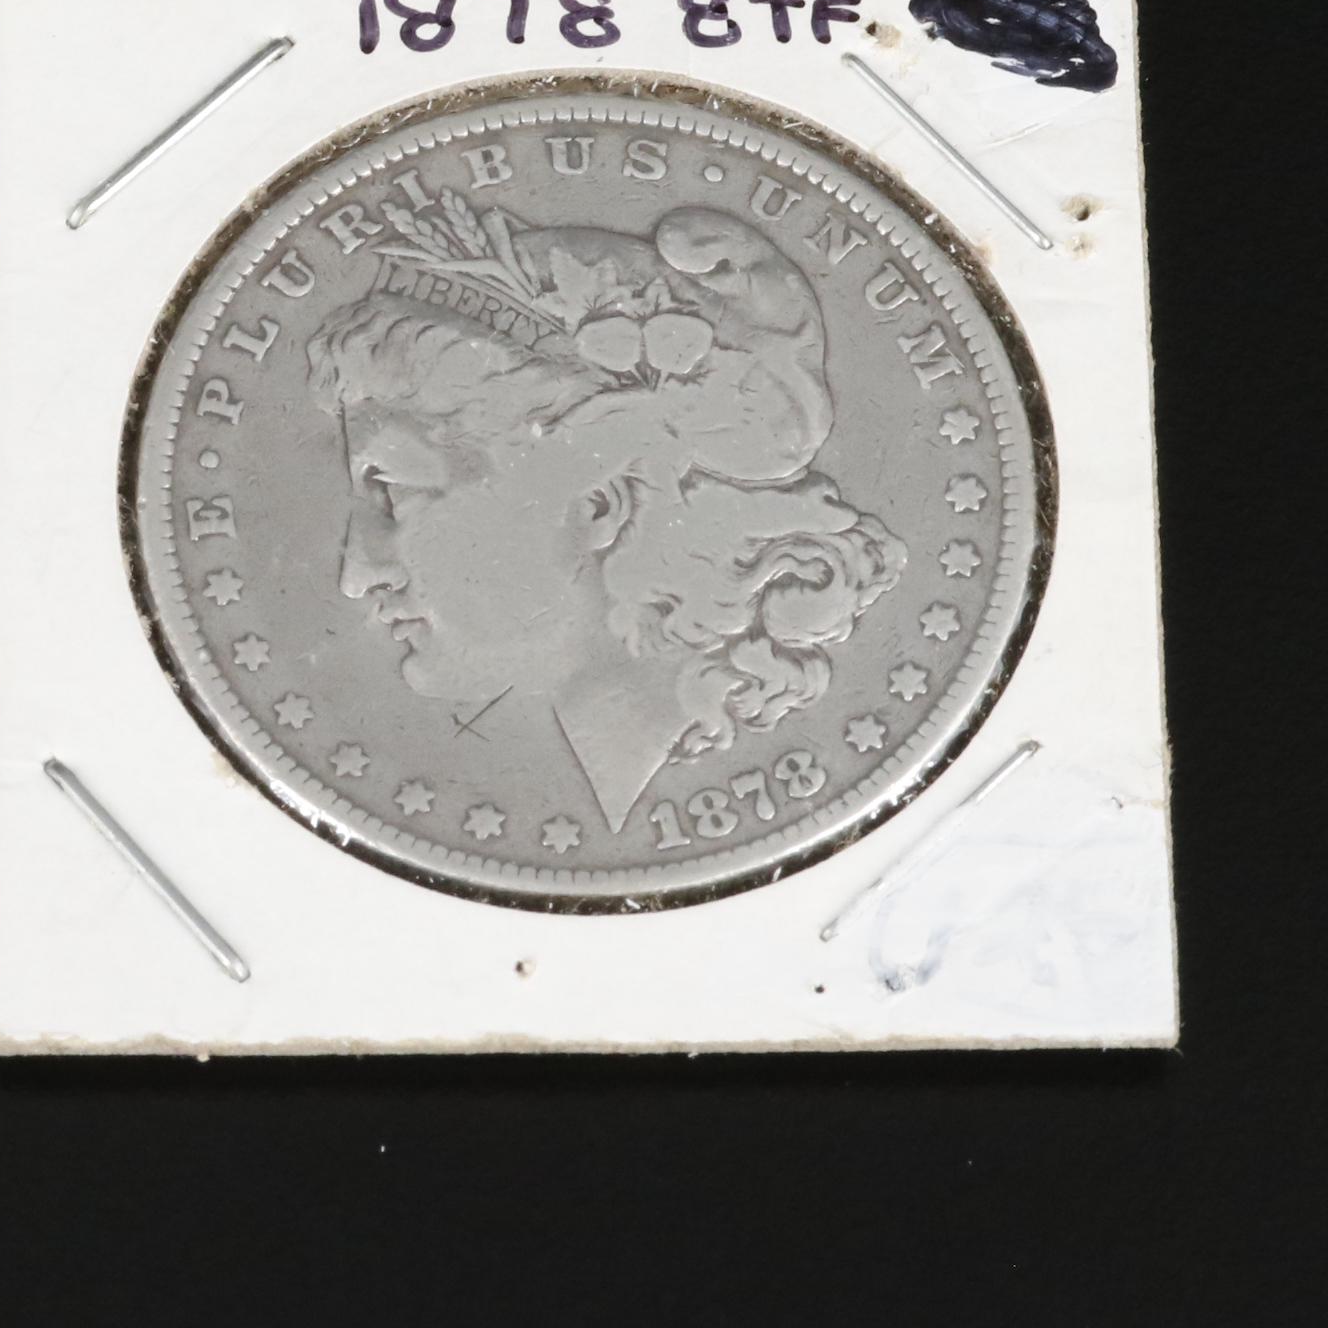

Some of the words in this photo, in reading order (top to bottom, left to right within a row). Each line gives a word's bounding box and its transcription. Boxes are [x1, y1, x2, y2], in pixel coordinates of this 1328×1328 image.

[197, 136, 669, 425] PLURIBUS
[375, 262, 558, 352] LIBERTY
[749, 175, 966, 391] UNUM
[187, 493, 237, 543] E
[649, 750, 829, 852] 1878
